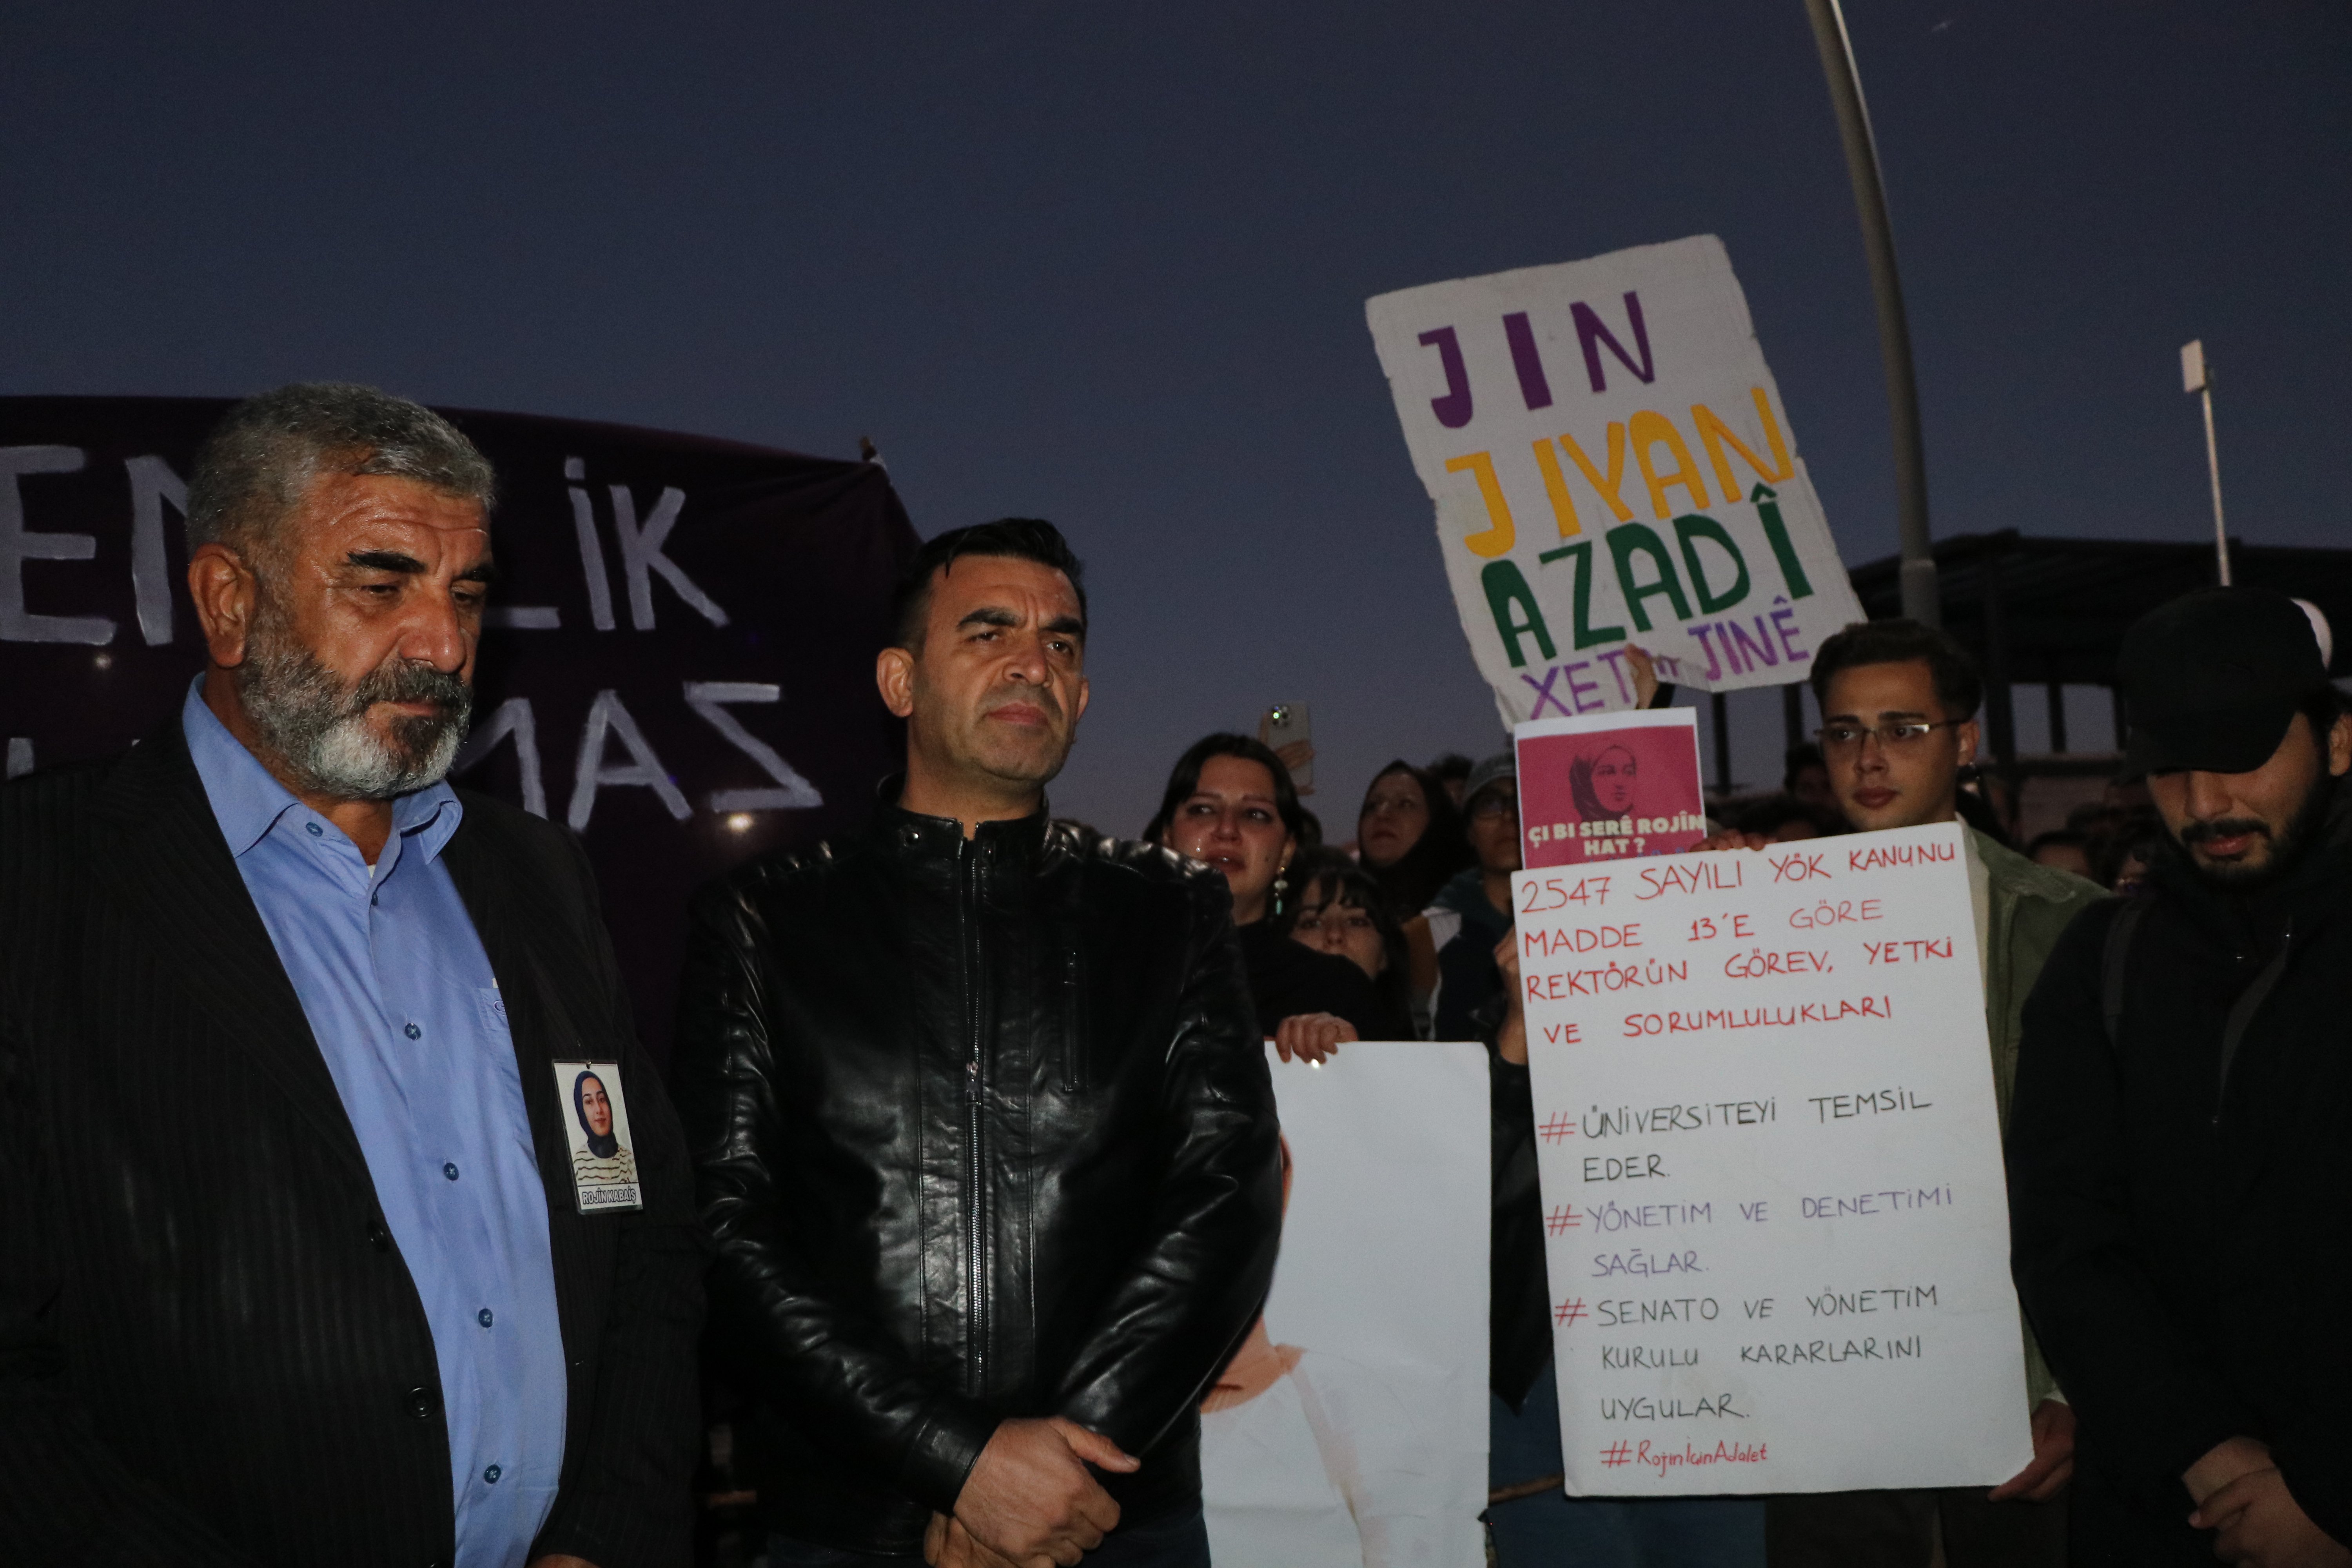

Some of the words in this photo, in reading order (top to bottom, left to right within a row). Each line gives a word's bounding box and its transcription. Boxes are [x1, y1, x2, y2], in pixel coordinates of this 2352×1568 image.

[1418, 291, 1655, 428] JIN
[1444, 387, 1795, 558] JIYAN
[1481, 482, 1814, 668] AZADÎ
[1688, 595, 1809, 681] JINÊ
[1528, 826, 1549, 849] ÇI
[1553, 822, 1575, 840] BI
[1579, 815, 1633, 837] SERÊ
[1521, 876, 1612, 913] 2547
[1635, 860, 1742, 901] SAYILI
[1768, 853, 1832, 883] YÖK
[1849, 842, 1955, 871] KANUNU
[1524, 923, 1643, 958] MADDE
[1789, 899, 1883, 929] GÖRE
[1526, 958, 1688, 1003] REKTÖRÜN
[1724, 947, 1833, 979] GÖREV,
[1863, 936, 1953, 965] YETKİ
[1543, 1023, 1582, 1044] VE
[1623, 995, 1891, 1038] SORUMLULUKLARI
[1808, 1086, 1933, 1124] TEMSİL
[1583, 1153, 1670, 1183] EDER.
[582, 1187, 607, 1205] ROJİN
[607, 1185, 636, 1204] KABAİŞ
[1739, 1202, 1768, 1222] VE
[1802, 1183, 1951, 1218] DENETİMİ
[1592, 1249, 1708, 1278] SAĞLAR.
[1744, 1298, 1774, 1319] VE
[1806, 1285, 1937, 1316] YÖNETİM
[1602, 1345, 1698, 1369] KURULU
[1740, 1335, 1921, 1365] KARARLARINI
[1601, 1393, 1749, 1421] UYGULAR.
